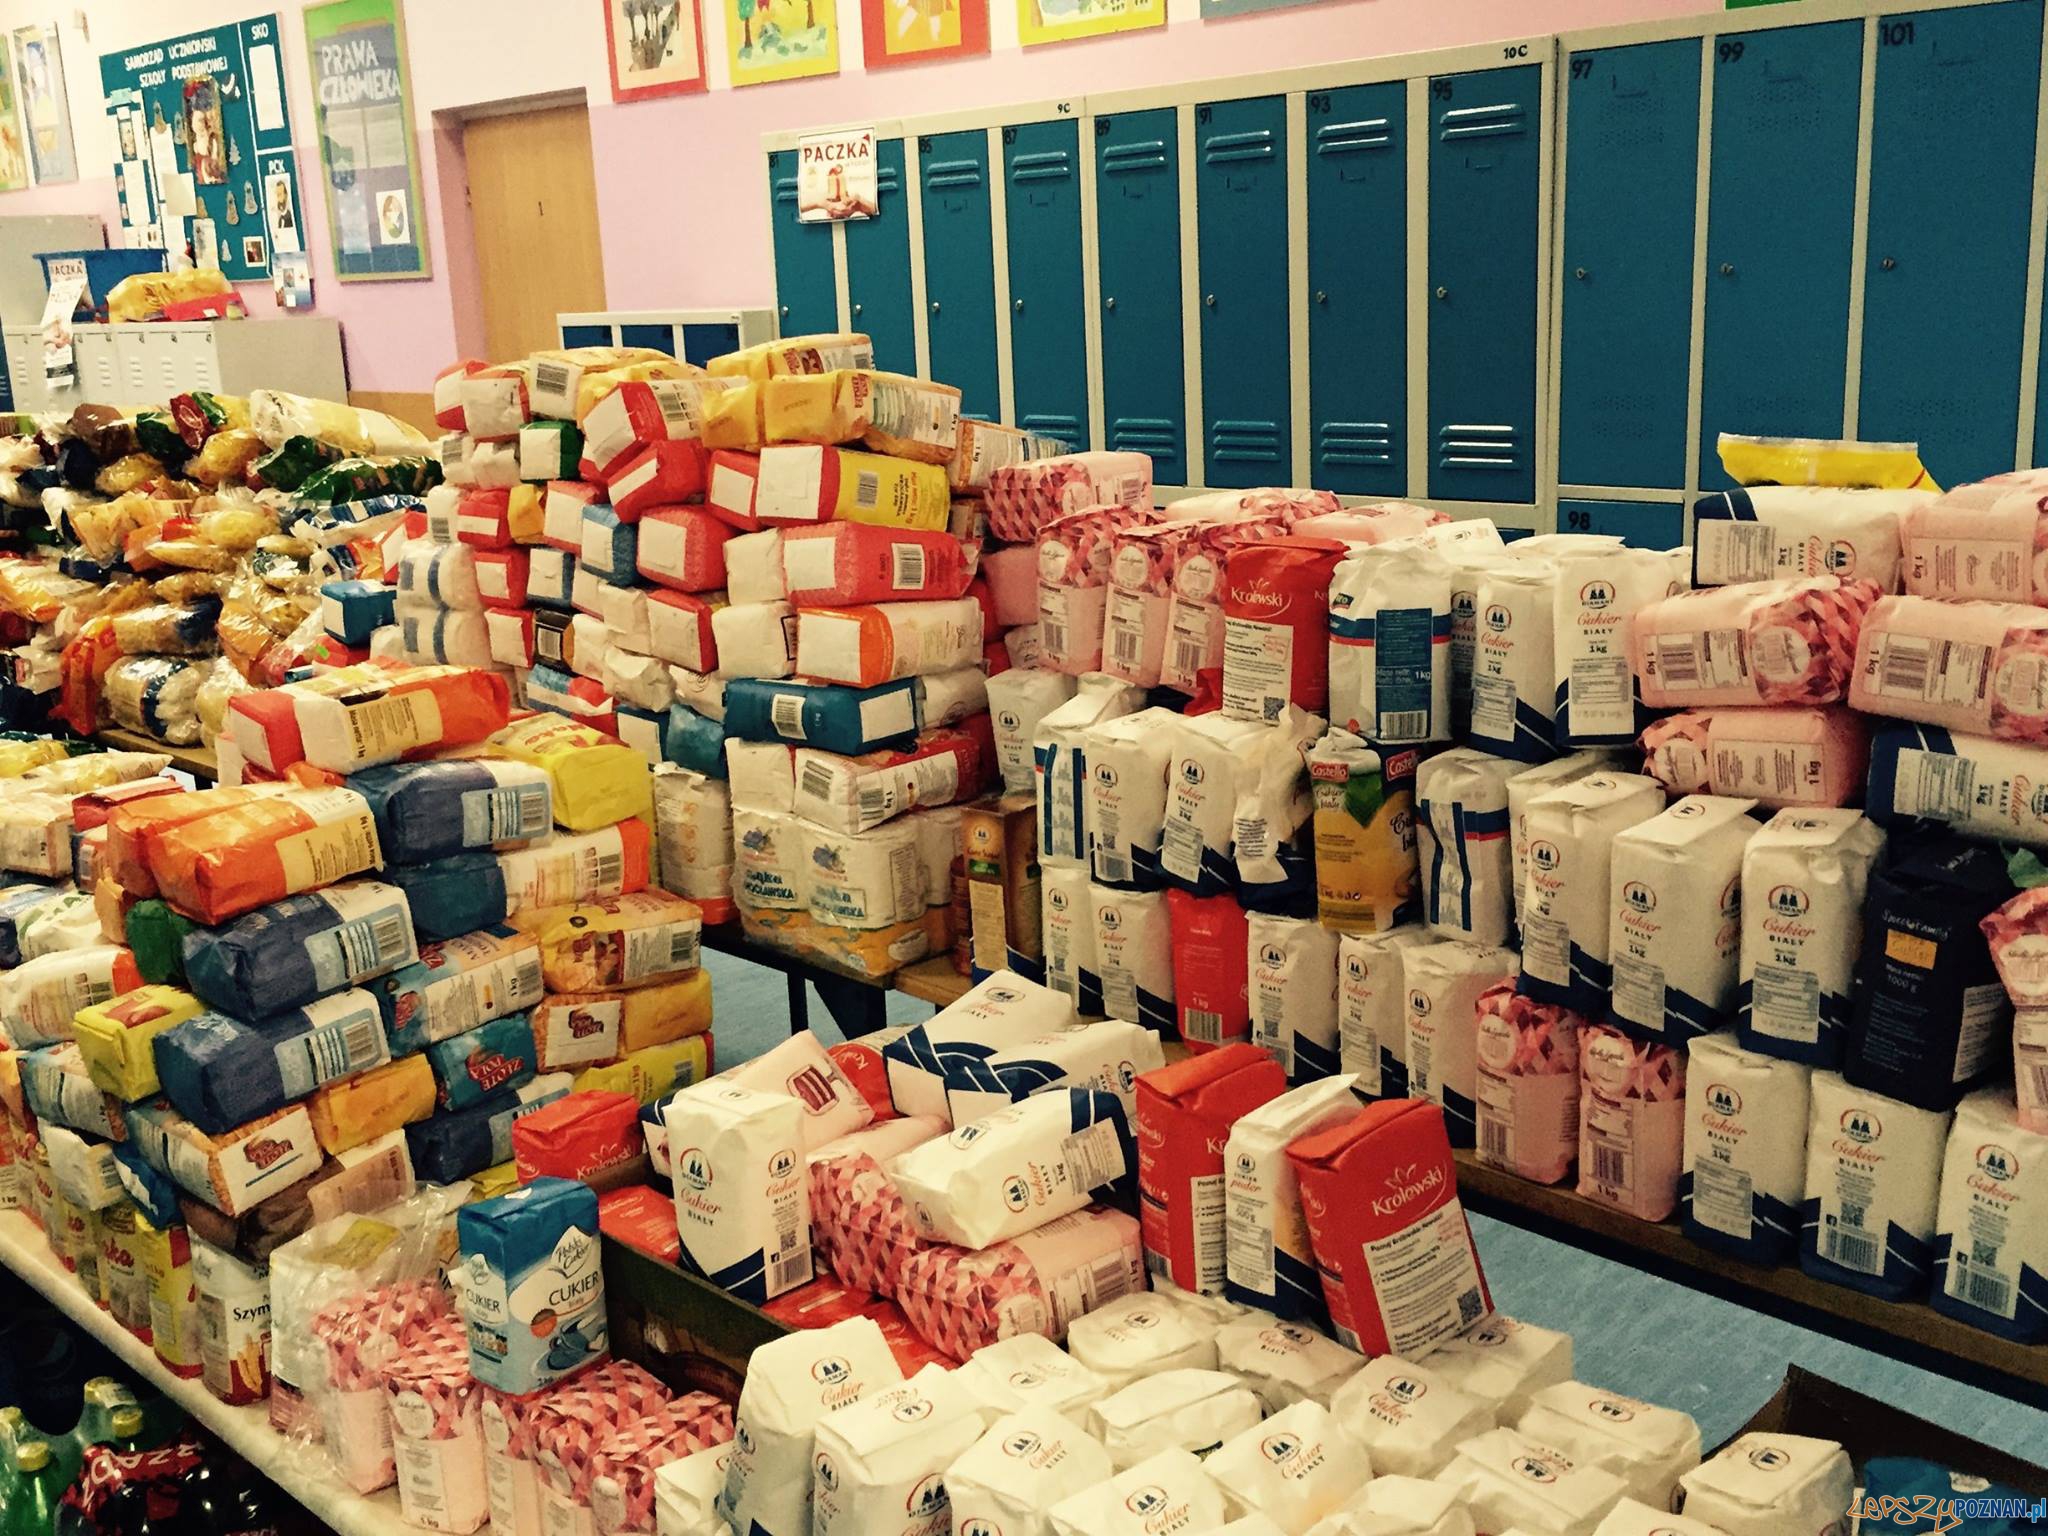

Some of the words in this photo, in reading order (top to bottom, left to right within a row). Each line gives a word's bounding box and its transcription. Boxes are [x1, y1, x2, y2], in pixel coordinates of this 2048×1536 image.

[251, 23, 269, 40] SKO
[1880, 23, 1914, 46] 101
[321, 40, 379, 75] PRAWA
[1503, 45, 1528, 60] 10C
[1719, 41, 1745, 63] 99
[1572, 59, 1594, 79] 97
[319, 69, 400, 105] CZŁOWIEKA
[1432, 81, 1454, 101] 95
[1057, 103, 1071, 114] 9C
[1311, 95, 1331, 114] 93
[804, 141, 870, 164] PACZKA
[1568, 510, 1591, 530] 98
[1913, 564, 1922, 580] kg
[1577, 611, 1622, 627] Cukier
[1481, 632, 1514, 649] Cukier
[1583, 628, 1613, 636] BIAŁY
[1485, 647, 1507, 658] BIAŁY
[1589, 645, 1595, 653] 1
[1595, 645, 1607, 654] kg
[1646, 660, 1656, 675] kg
[1866, 659, 1880, 676] kg
[1807, 761, 1821, 776] kg
[1620, 909, 1661, 933] Cukier
[1763, 918, 1816, 938] Cukier
[1625, 927, 1652, 941] BIAŁY
[1770, 935, 1804, 947] BIAŁY
[1635, 946, 1646, 958] kg
[1775, 954, 1783, 963] 1
[1783, 956, 1797, 966] kg
[1702, 1113, 1748, 1136] Cukier
[1707, 1130, 1739, 1144] BIAŁY
[1832, 1139, 1885, 1162] Cukier
[1839, 1158, 1875, 1173] BIAŁY
[765, 1177, 800, 1199] Cukier
[1027, 1161, 1045, 1206] Cukier
[1040, 1164, 1052, 1195] BIAŁY
[1230, 1179, 1262, 1193] puder
[1967, 1174, 2020, 1202] Cukier
[680, 1186, 722, 1215] Cukier
[773, 1190, 797, 1204] BIAŁY
[1973, 1193, 2009, 1212] BIAŁY
[687, 1210, 714, 1226] BIAŁY
[549, 1270, 599, 1307] CUKIER
[465, 1288, 500, 1313] CUKIER
[233, 1303, 270, 1324] Szym
[1260, 1344, 1287, 1356] BIAŁY
[821, 1381, 864, 1406] Cukier
[831, 1395, 860, 1411] BIAŁY
[1368, 1392, 1412, 1419] Cukier
[1369, 1407, 1400, 1427] BIAŁY
[1029, 1439, 1063, 1469] Cukier
[1045, 1450, 1069, 1469] BIAŁY
[1281, 1441, 1324, 1480] Cukier
[1296, 1454, 1326, 1480] BIAŁY
[1144, 1500, 1191, 1536] Cukier
[1160, 1516, 1191, 1536] BIAŁY
